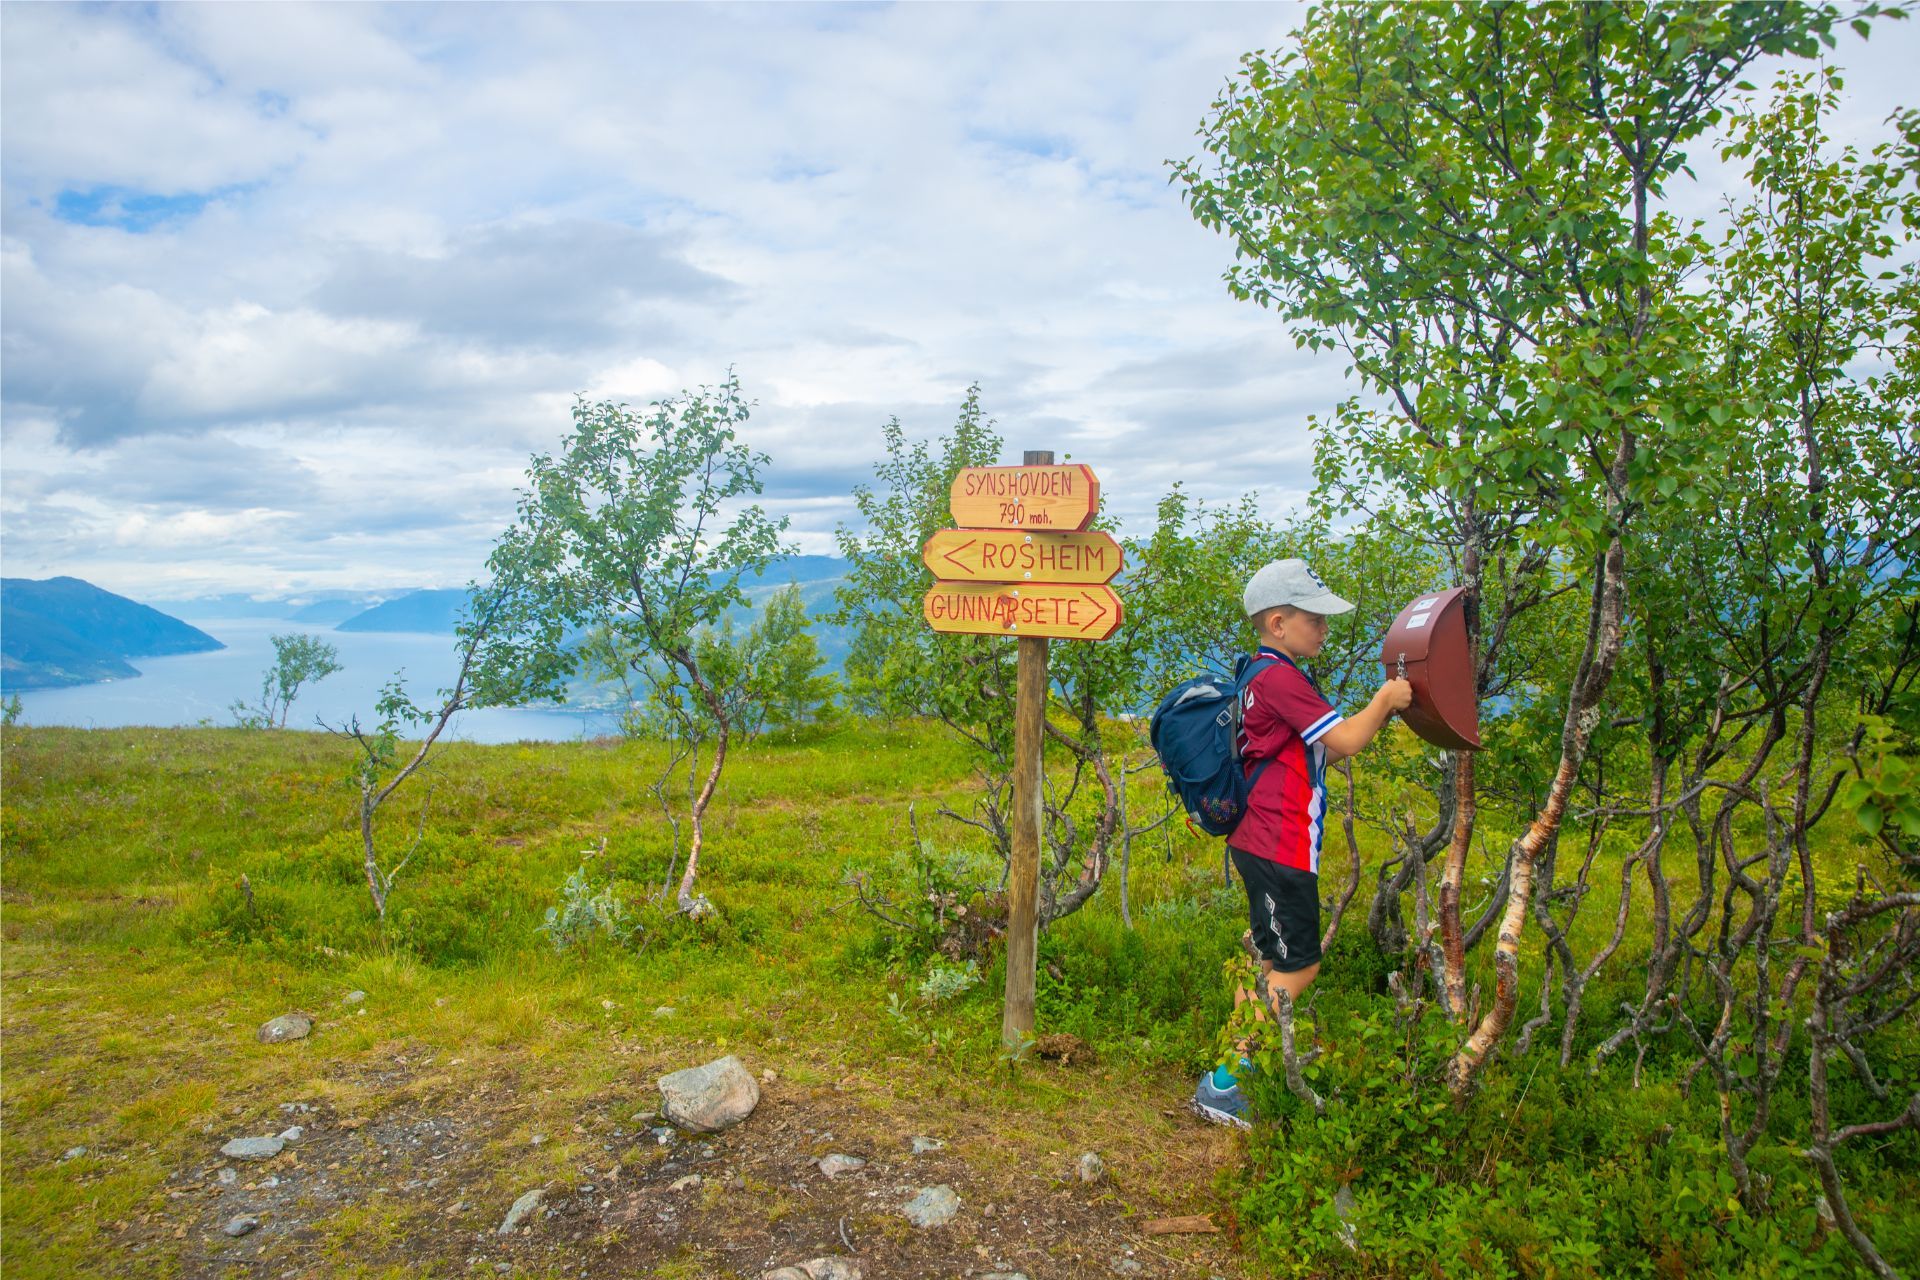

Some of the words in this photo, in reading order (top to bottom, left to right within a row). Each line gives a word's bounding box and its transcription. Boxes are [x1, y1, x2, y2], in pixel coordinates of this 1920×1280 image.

[965, 471, 1072, 496] SYNSHOVDEN
[999, 503, 1025, 524] 790
[1029, 508, 1052, 524] moh.
[982, 542, 1104, 572] ROSHEIM
[931, 594, 1080, 626] GUNNARSETE
